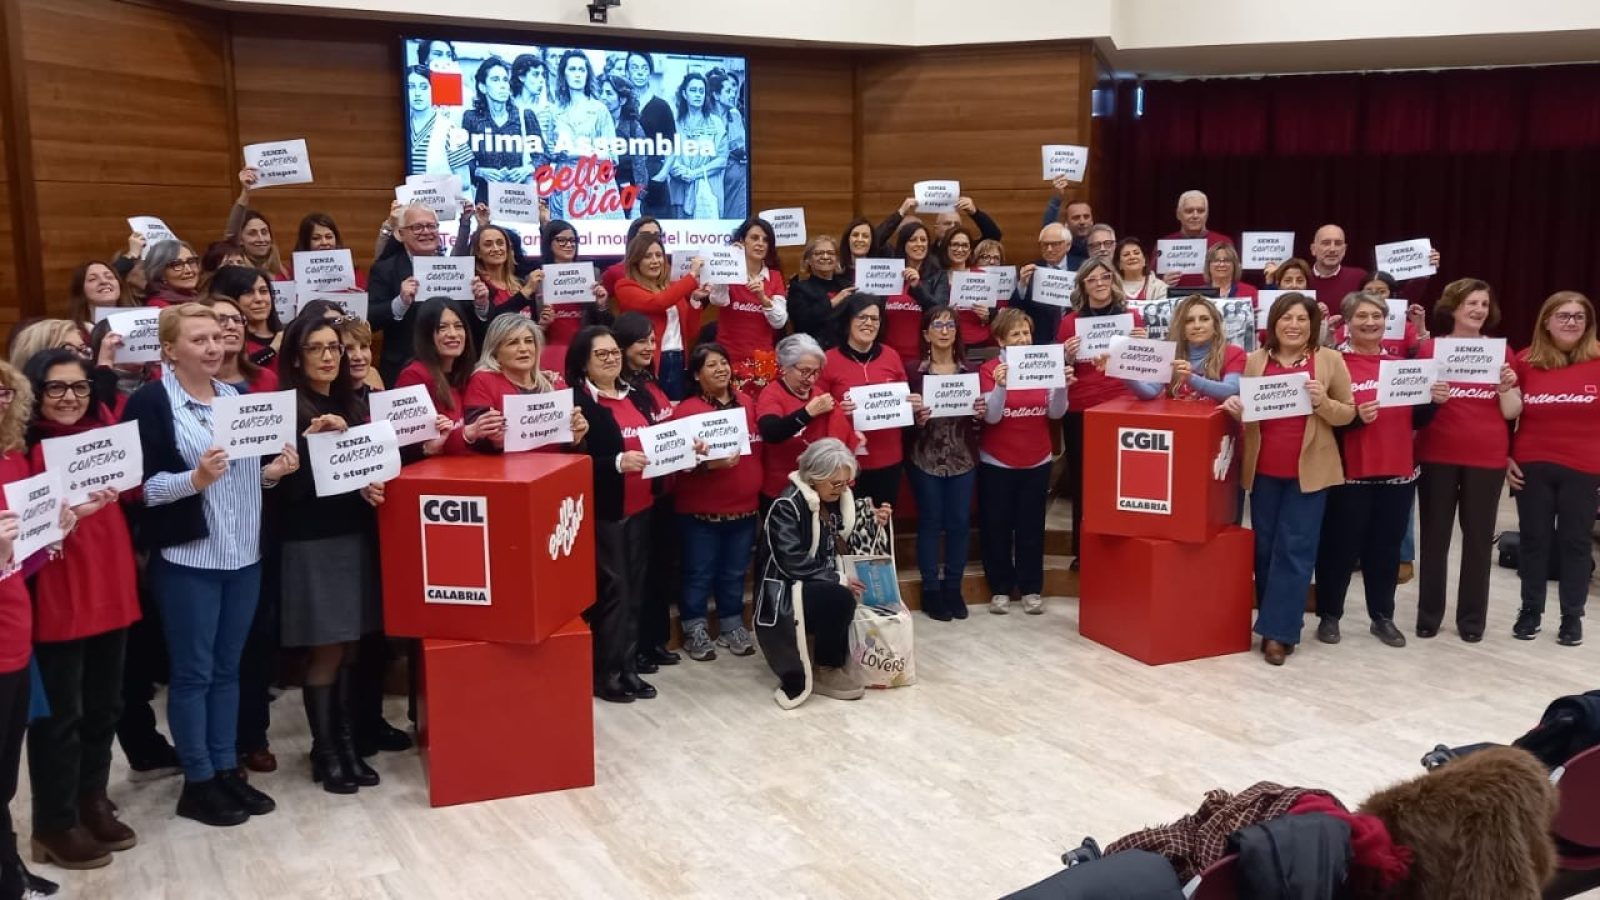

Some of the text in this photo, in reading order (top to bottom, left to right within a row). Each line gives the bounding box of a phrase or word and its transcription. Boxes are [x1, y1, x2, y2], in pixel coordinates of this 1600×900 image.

[450, 128, 716, 156] Prima Assemblea
[262, 148, 288, 156] SENZA
[534, 153, 615, 197] Belle
[568, 185, 641, 218] Ciao
[685, 231, 732, 245] lavoro
[134, 318, 160, 326] SENZ
[130, 329, 160, 339] CONSE
[138, 344, 161, 352] stup
[1128, 344, 1155, 353] SENZA
[1120, 352, 1163, 363] CONSENSO
[1447, 354, 1493, 364] CONSENSO
[1018, 360, 1056, 370] CONSENSO
[1126, 366, 1158, 374] stupro
[1260, 382, 1288, 390] SENZA
[869, 391, 893, 399] SENZA
[934, 389, 972, 399] CONSENSO
[1254, 390, 1298, 401] CONSENSO
[392, 396, 418, 408] SENZA
[526, 401, 556, 412] SENZA
[864, 398, 900, 410] CONSENSO
[942, 402, 968, 410] stupro
[1262, 402, 1296, 411] stupro
[239, 404, 272, 414] SENZA
[386, 406, 428, 422] CONSENSO
[230, 414, 284, 430] CONSENSO
[520, 410, 564, 426] CONSENSO
[702, 418, 728, 427] SENZA
[872, 412, 900, 422] stupro
[529, 427, 560, 438] stupro
[656, 430, 677, 440] SENZA
[230, 433, 278, 446] è stupro
[336, 435, 372, 449] SENZA
[1121, 431, 1169, 450] CGIL
[76, 438, 113, 455] SENZA
[330, 445, 384, 466] CONSENSO
[68, 450, 126, 473] CONSENSO
[333, 463, 384, 480] è stupro
[70, 471, 124, 490] è stupro
[1119, 500, 1168, 511] CALABRIA
[424, 500, 484, 523] CGIL
[428, 589, 487, 601] CALABRIA
